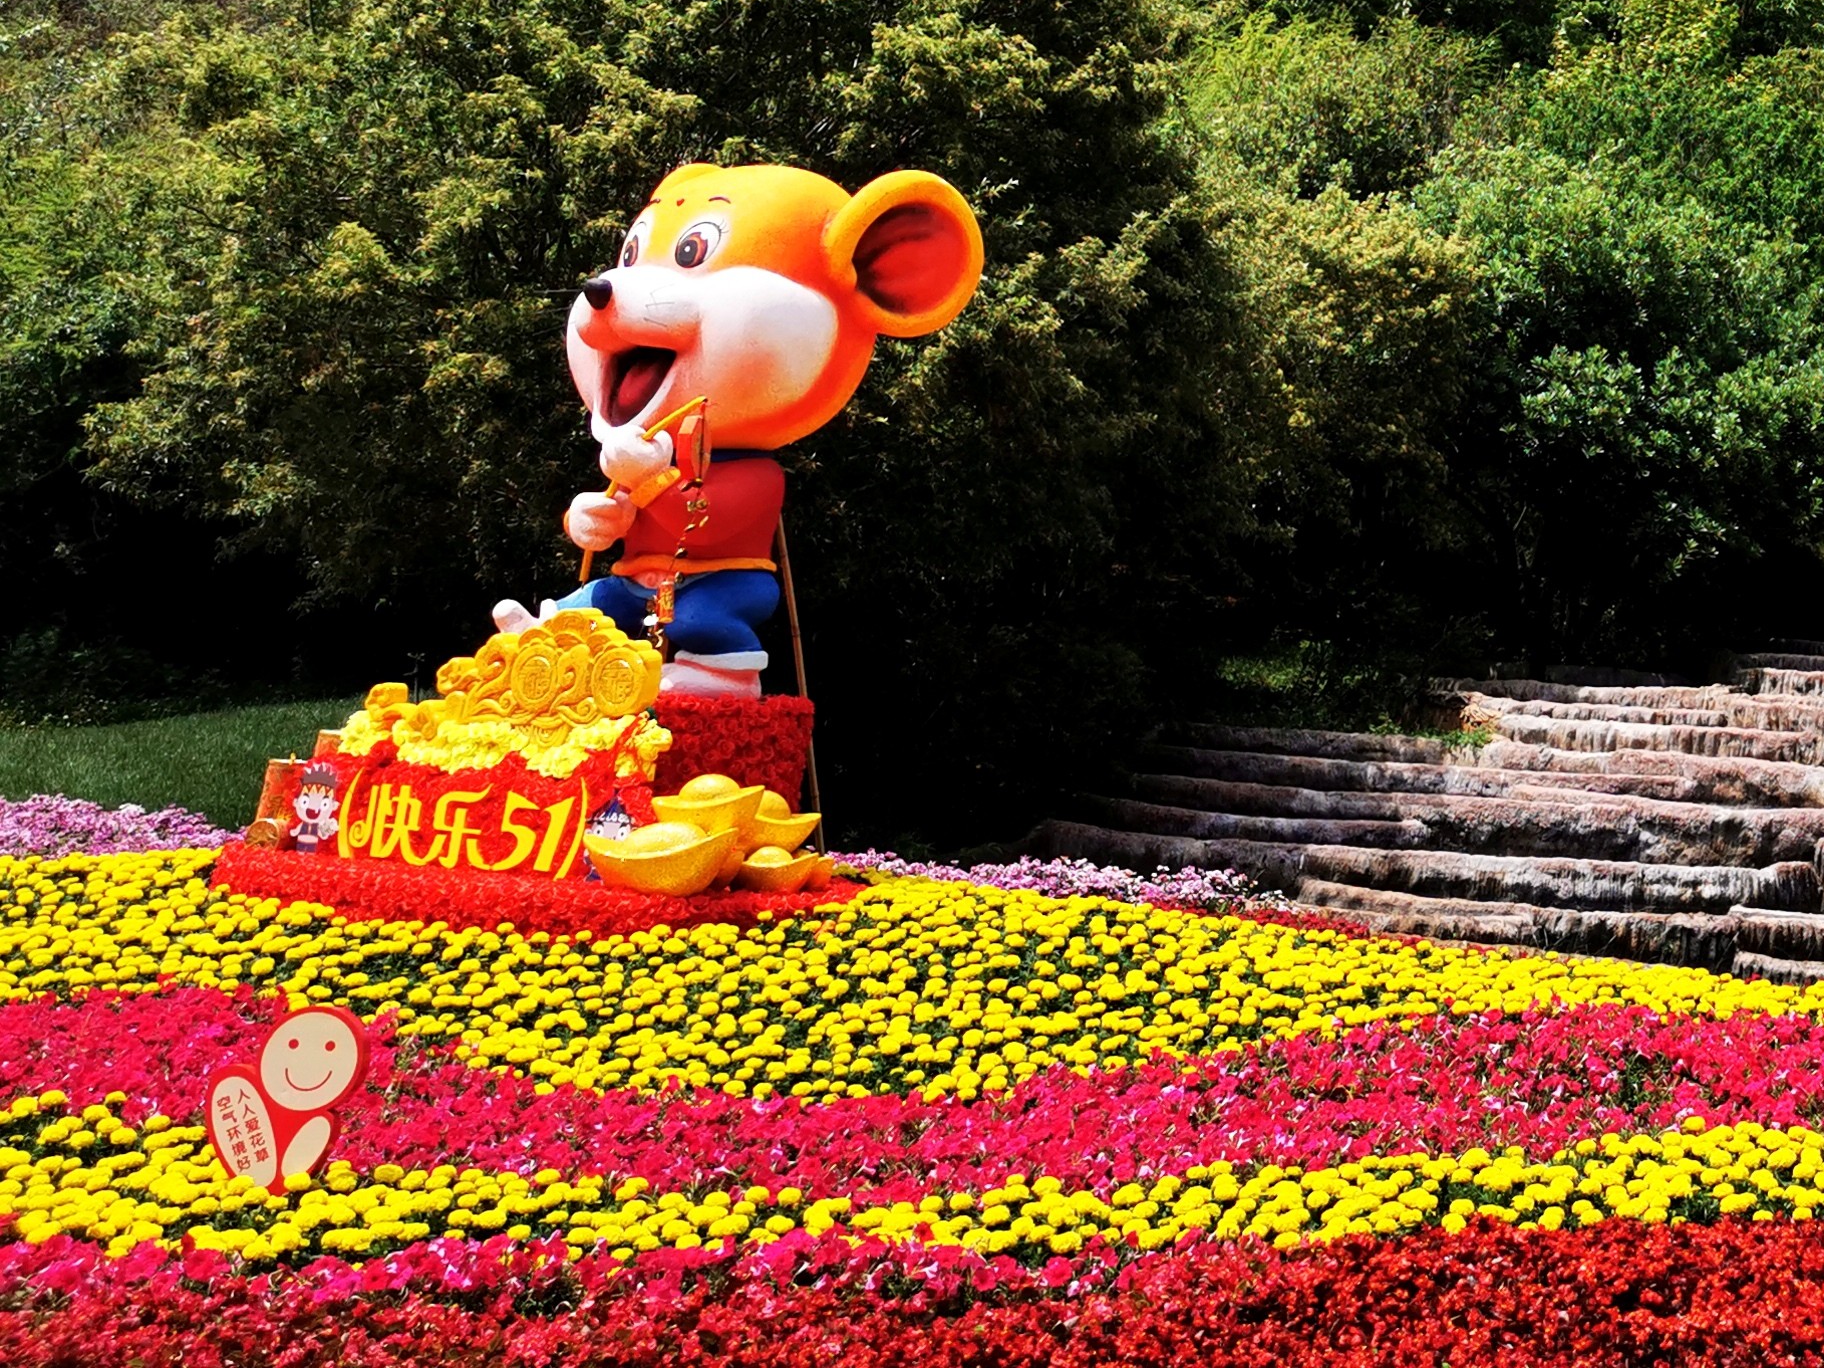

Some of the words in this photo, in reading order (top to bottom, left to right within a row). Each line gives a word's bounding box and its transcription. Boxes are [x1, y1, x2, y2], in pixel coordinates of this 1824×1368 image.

[216, 1095, 252, 1172] 空气环境好
[237, 1088, 270, 1163] 人人爱花草
